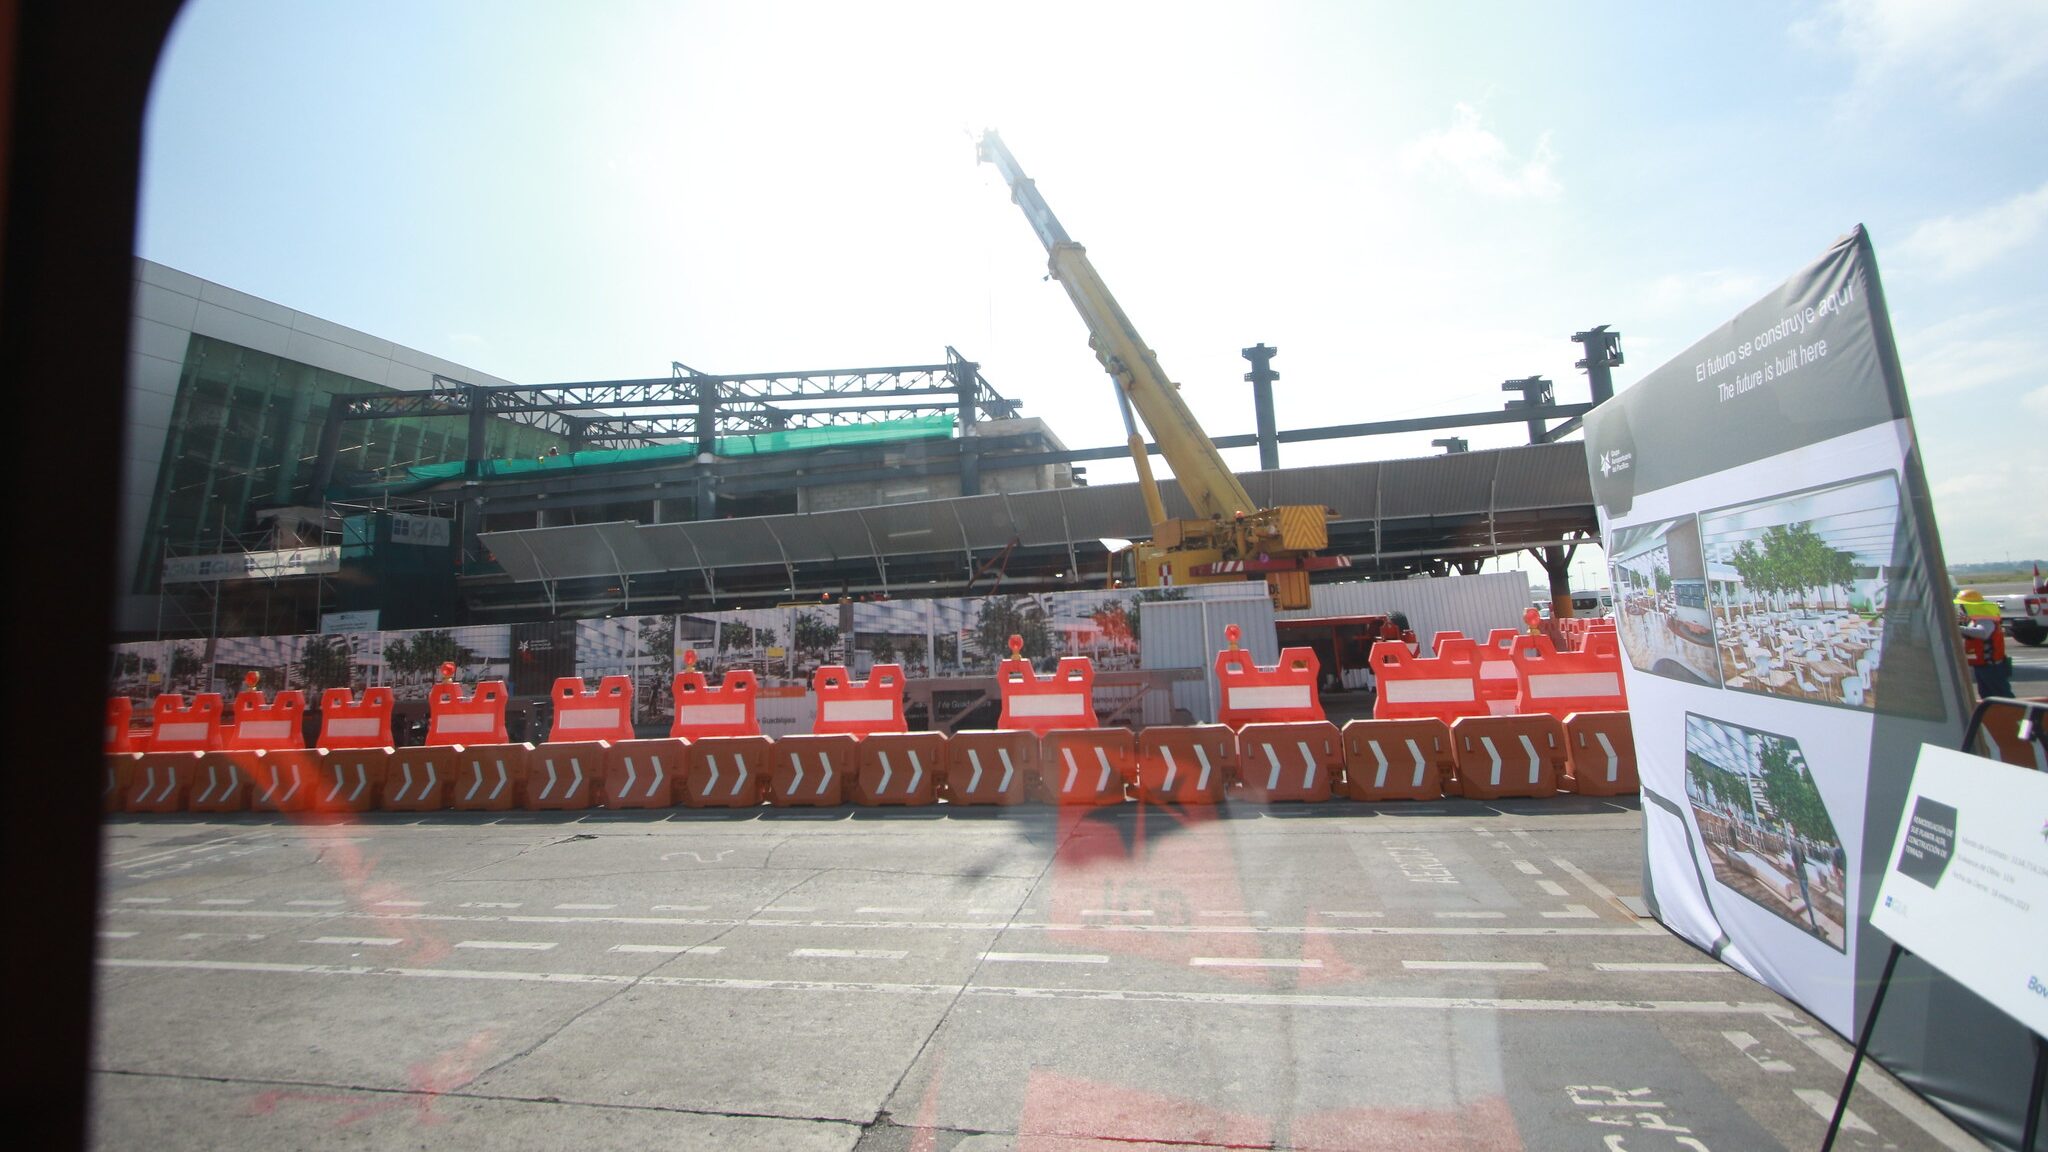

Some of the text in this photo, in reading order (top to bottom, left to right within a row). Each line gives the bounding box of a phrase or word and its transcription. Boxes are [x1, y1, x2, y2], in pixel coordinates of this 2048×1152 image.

[1696, 362, 1706, 382] El
[1707, 350, 1736, 377] futuro
[1738, 341, 1752, 360] se
[1754, 307, 1815, 351] construye
[1718, 339, 1828, 402] The future is built here
